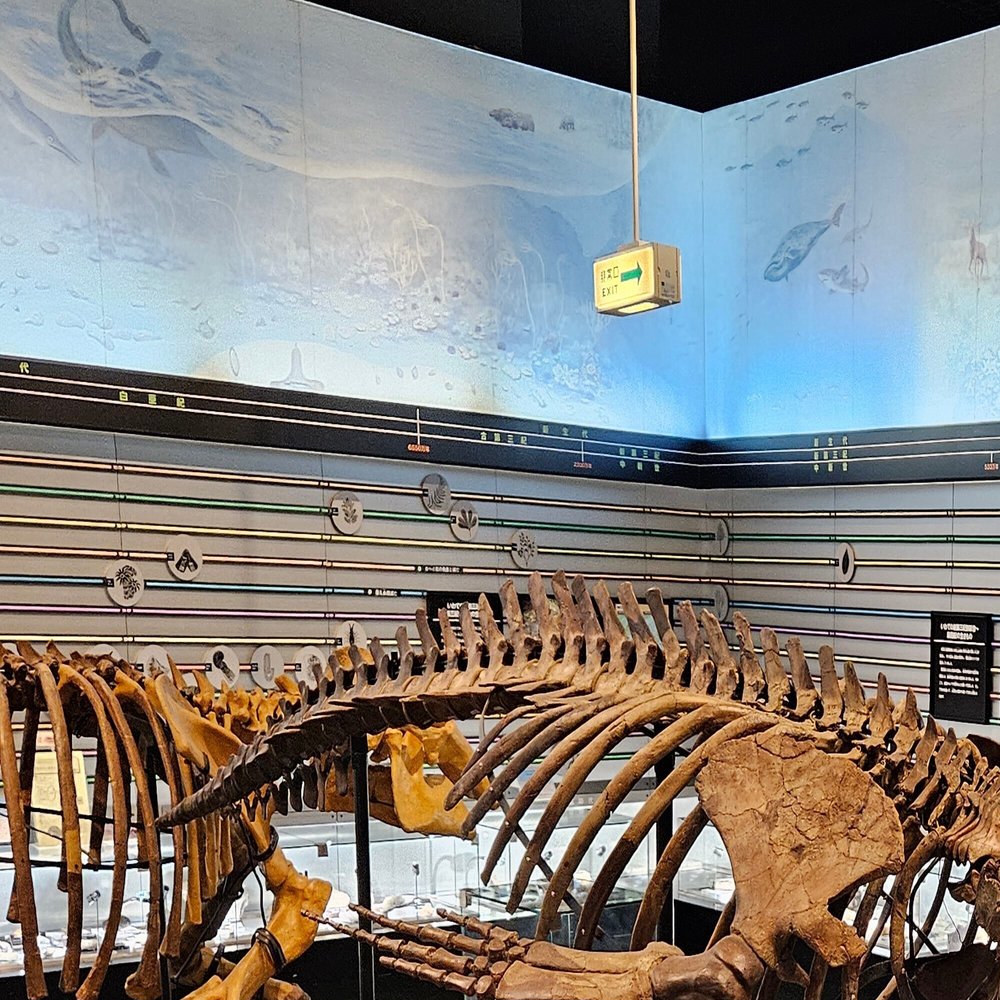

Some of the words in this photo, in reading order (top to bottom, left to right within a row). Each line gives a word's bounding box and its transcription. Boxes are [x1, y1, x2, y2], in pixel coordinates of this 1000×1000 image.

[600, 266, 619, 283] 非常口
[602, 284, 618, 298] EXIT
[19, 361, 30, 374] 代
